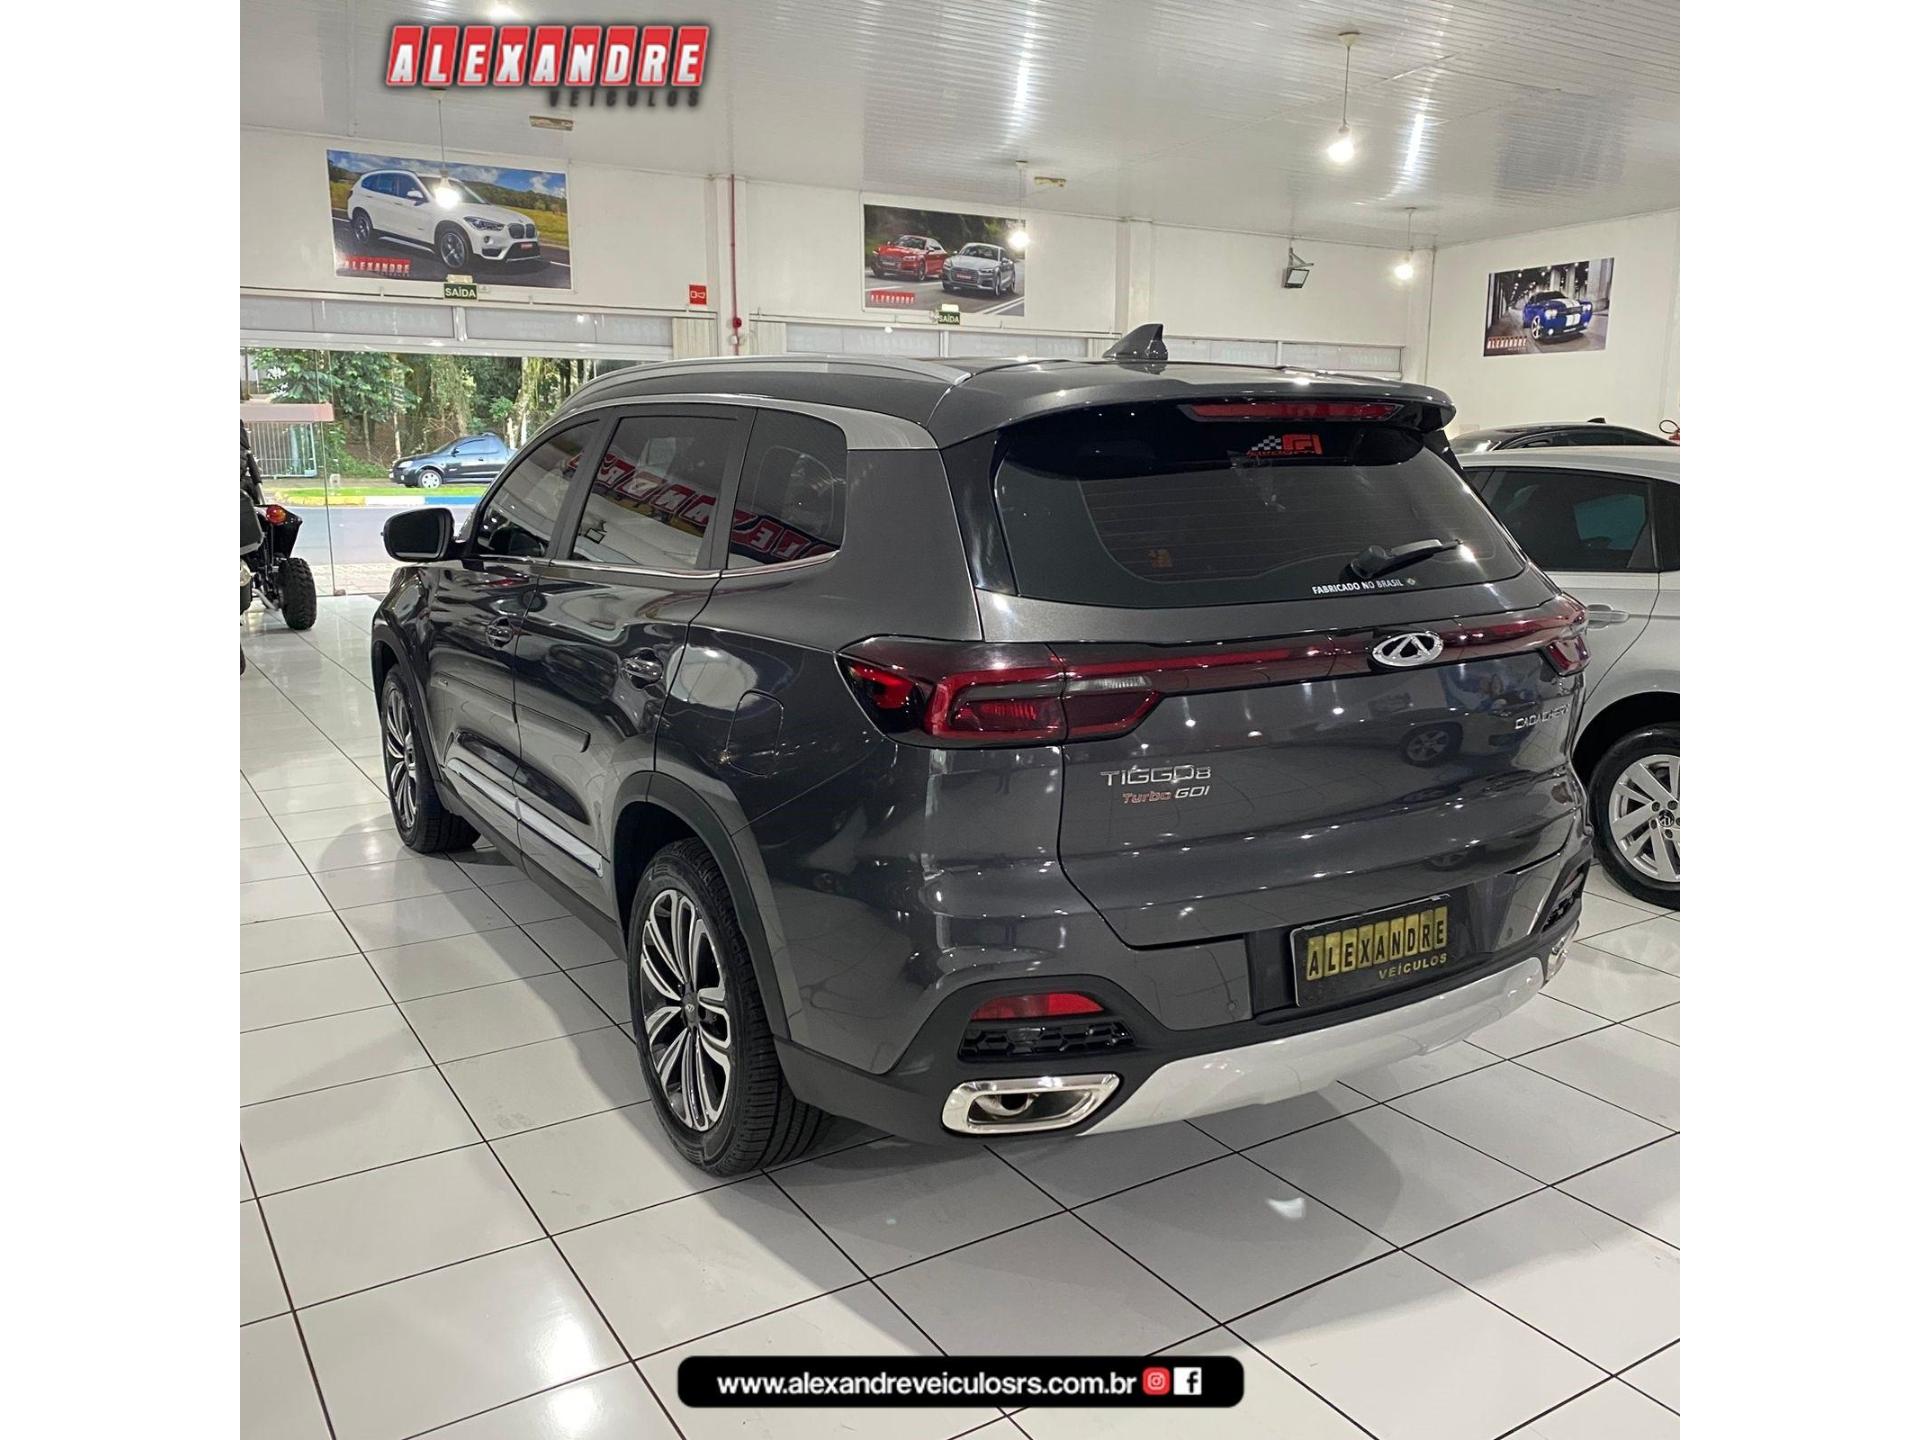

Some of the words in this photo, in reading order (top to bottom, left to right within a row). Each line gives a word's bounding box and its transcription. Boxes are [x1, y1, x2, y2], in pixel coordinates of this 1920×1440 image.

[445, 286, 477, 298] SAÍDA
[938, 313, 959, 323] SAÍDA
[1312, 582, 1361, 595] FABRICADO
[1361, 580, 1375, 590] NO
[1376, 578, 1404, 588] BRASIL
[1122, 791, 1172, 804] Turbo
[1175, 785, 1211, 799] GDI
[1308, 919, 1445, 977] ALEXANDRE
[1378, 952, 1448, 980] VEÍCULOS
